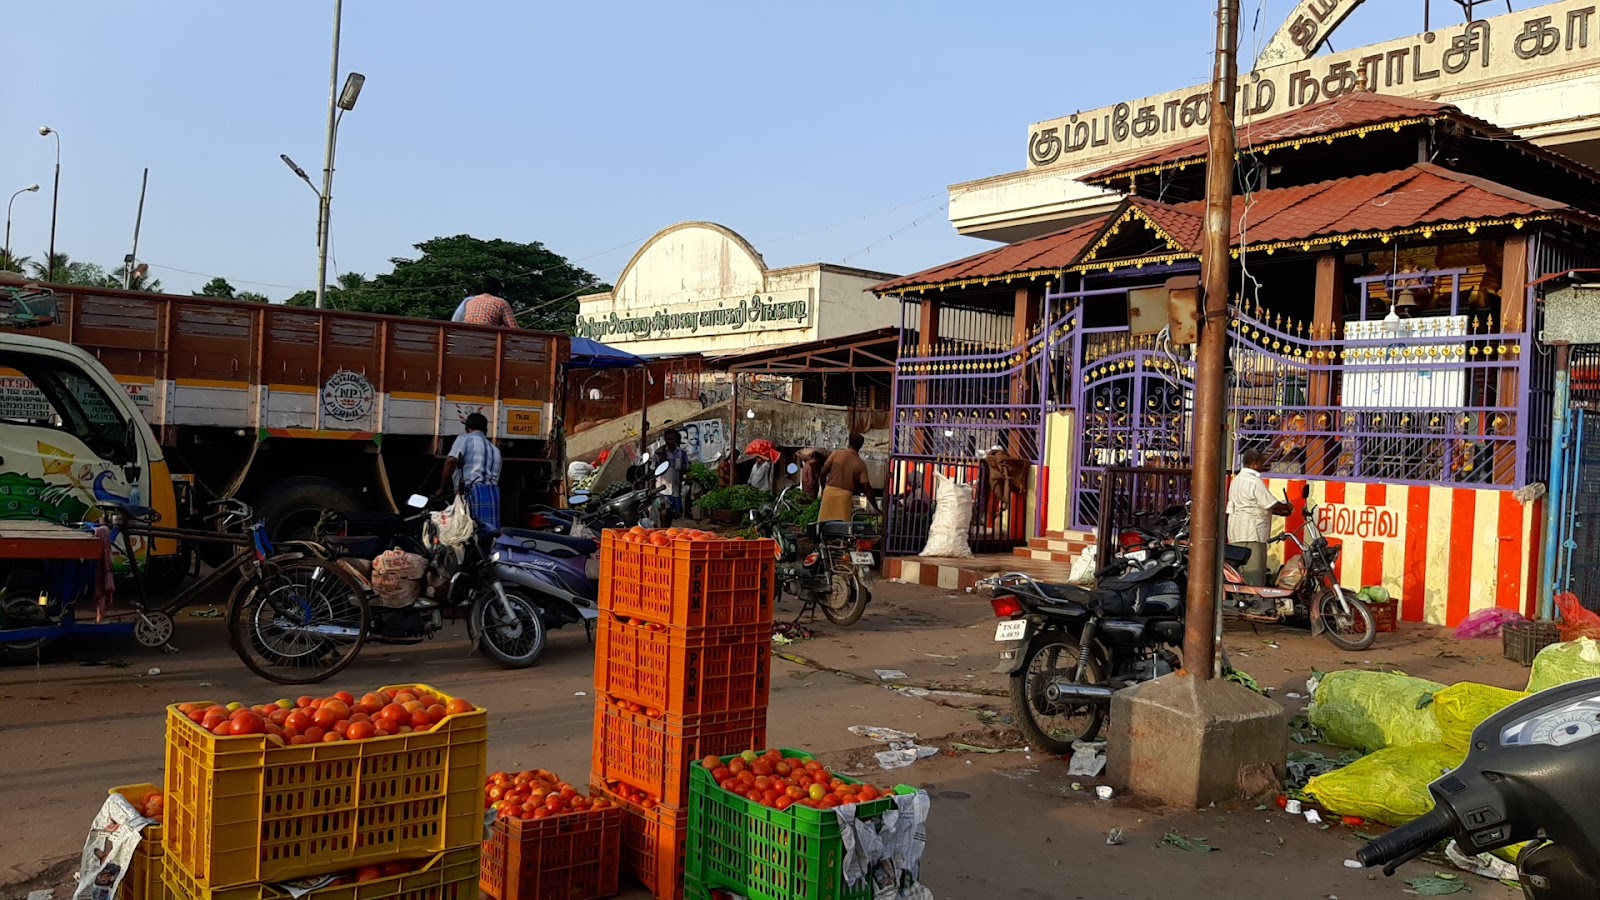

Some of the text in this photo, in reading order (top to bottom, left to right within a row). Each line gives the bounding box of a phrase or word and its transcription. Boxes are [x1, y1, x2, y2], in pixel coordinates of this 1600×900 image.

[1288, 19, 1491, 107] நகராட்சி
[699, 300, 747, 330] காய்கறி
[747, 295, 807, 324] அங்காடி
[326, 401, 365, 418] PERMIT
[339, 388, 358, 399] NP
[691, 564, 703, 611] PRM
[687, 652, 698, 698] PRM
